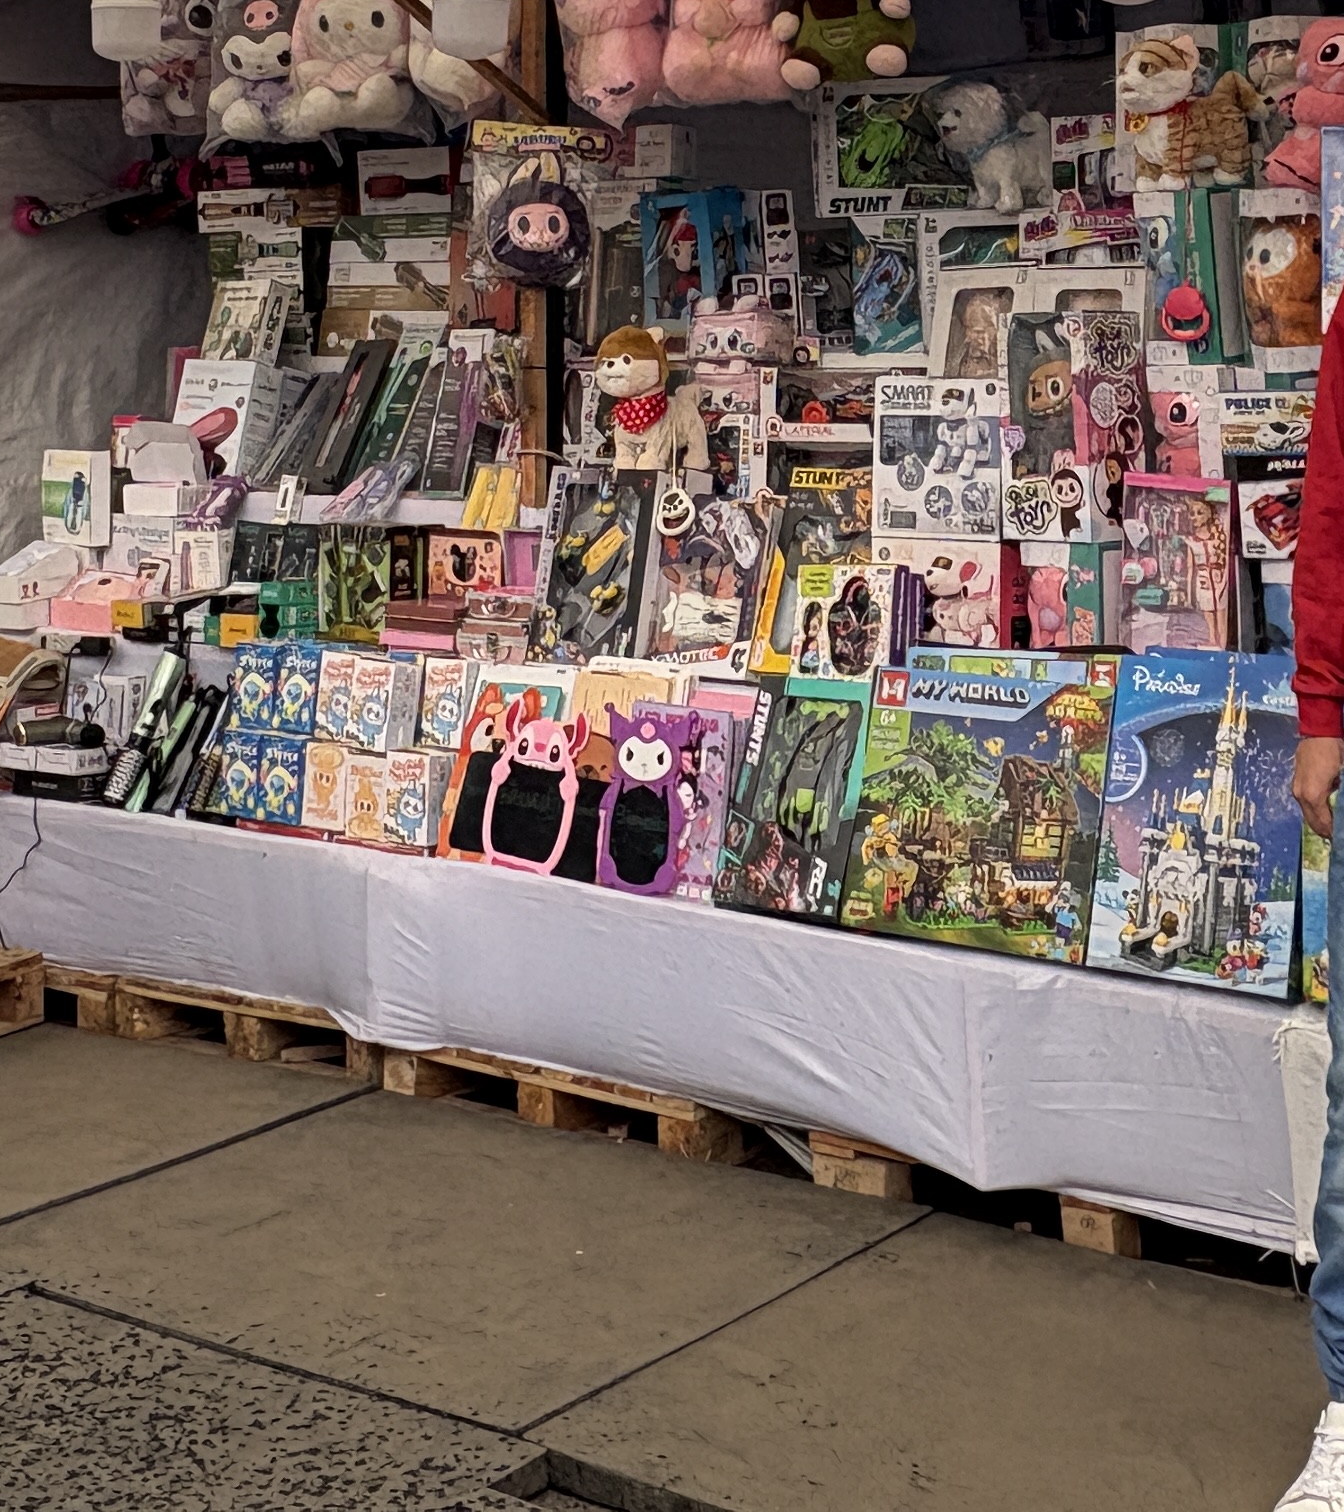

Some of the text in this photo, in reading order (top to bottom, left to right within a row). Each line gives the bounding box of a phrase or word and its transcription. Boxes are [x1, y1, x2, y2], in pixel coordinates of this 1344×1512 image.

[828, 196, 892, 214] STUNT
[1092, 341, 1132, 370] TOYS
[880, 384, 934, 401] SMART
[1008, 499, 1053, 531] TOYS
[949, 683, 1032, 707] WORLD
[745, 689, 773, 766] STUNTS
